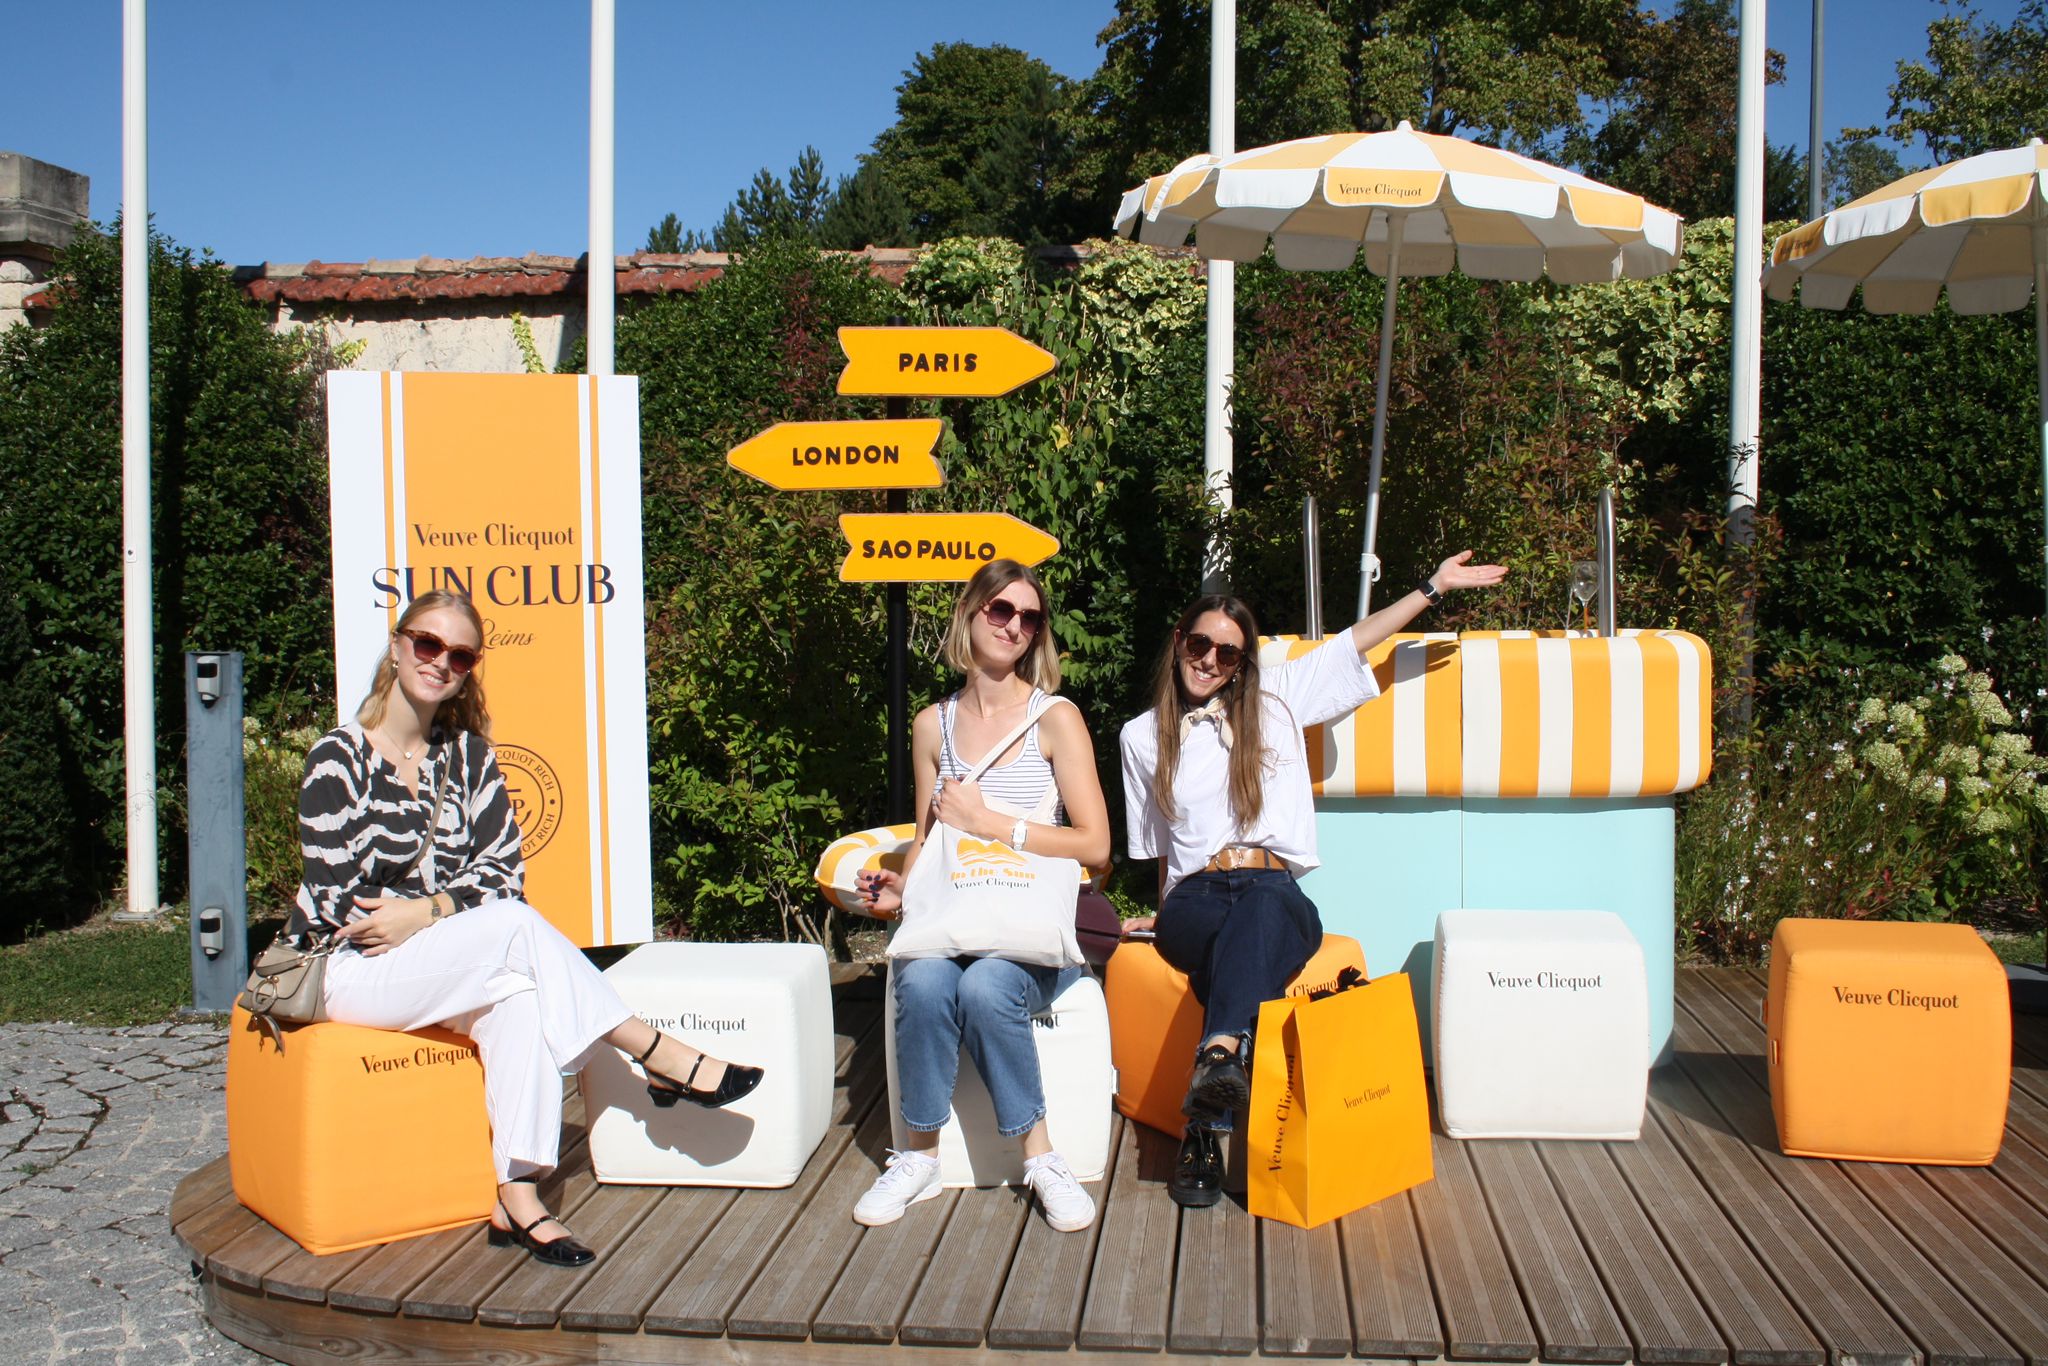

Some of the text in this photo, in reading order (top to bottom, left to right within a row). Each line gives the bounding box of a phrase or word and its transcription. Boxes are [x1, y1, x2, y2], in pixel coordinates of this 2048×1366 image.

[1339, 183, 1422, 198] Veuve Clicquot
[898, 352, 978, 373] PARIS
[792, 444, 899, 467] LONDON
[411, 522, 575, 551] Veuve Clicquot
[861, 539, 997, 561] SAO PAULO
[486, 563, 616, 607] CLUB
[534, 764, 555, 791] RICH
[535, 812, 555, 841] RICH
[954, 877, 1030, 890] Veuve Clicquot
[1486, 971, 1603, 992] Veuve Clicquot
[1832, 985, 1960, 1011] Veuve Clicquot
[680, 1012, 747, 1035] Clicquot
[360, 1054, 410, 1075] Veuve
[1268, 1126, 1285, 1172] Veuve
